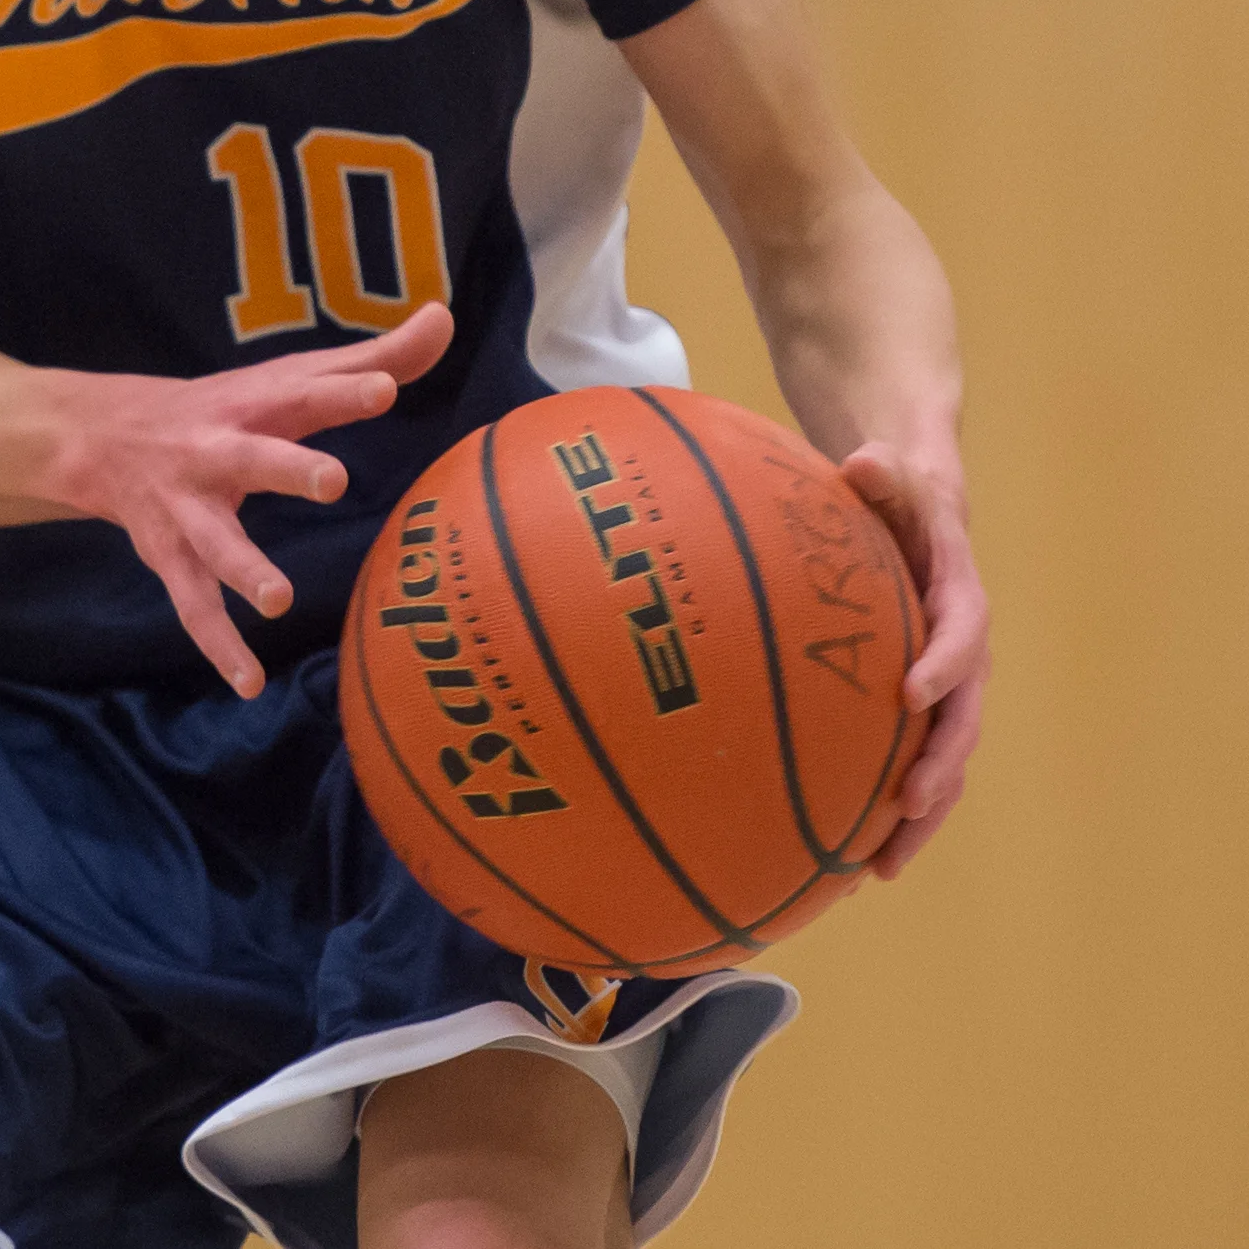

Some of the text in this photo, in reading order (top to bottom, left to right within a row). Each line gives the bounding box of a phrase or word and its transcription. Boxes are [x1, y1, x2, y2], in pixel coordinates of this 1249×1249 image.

[206, 121, 452, 343] 10
[378, 497, 572, 820] Baden
[549, 431, 702, 717] ELITE
